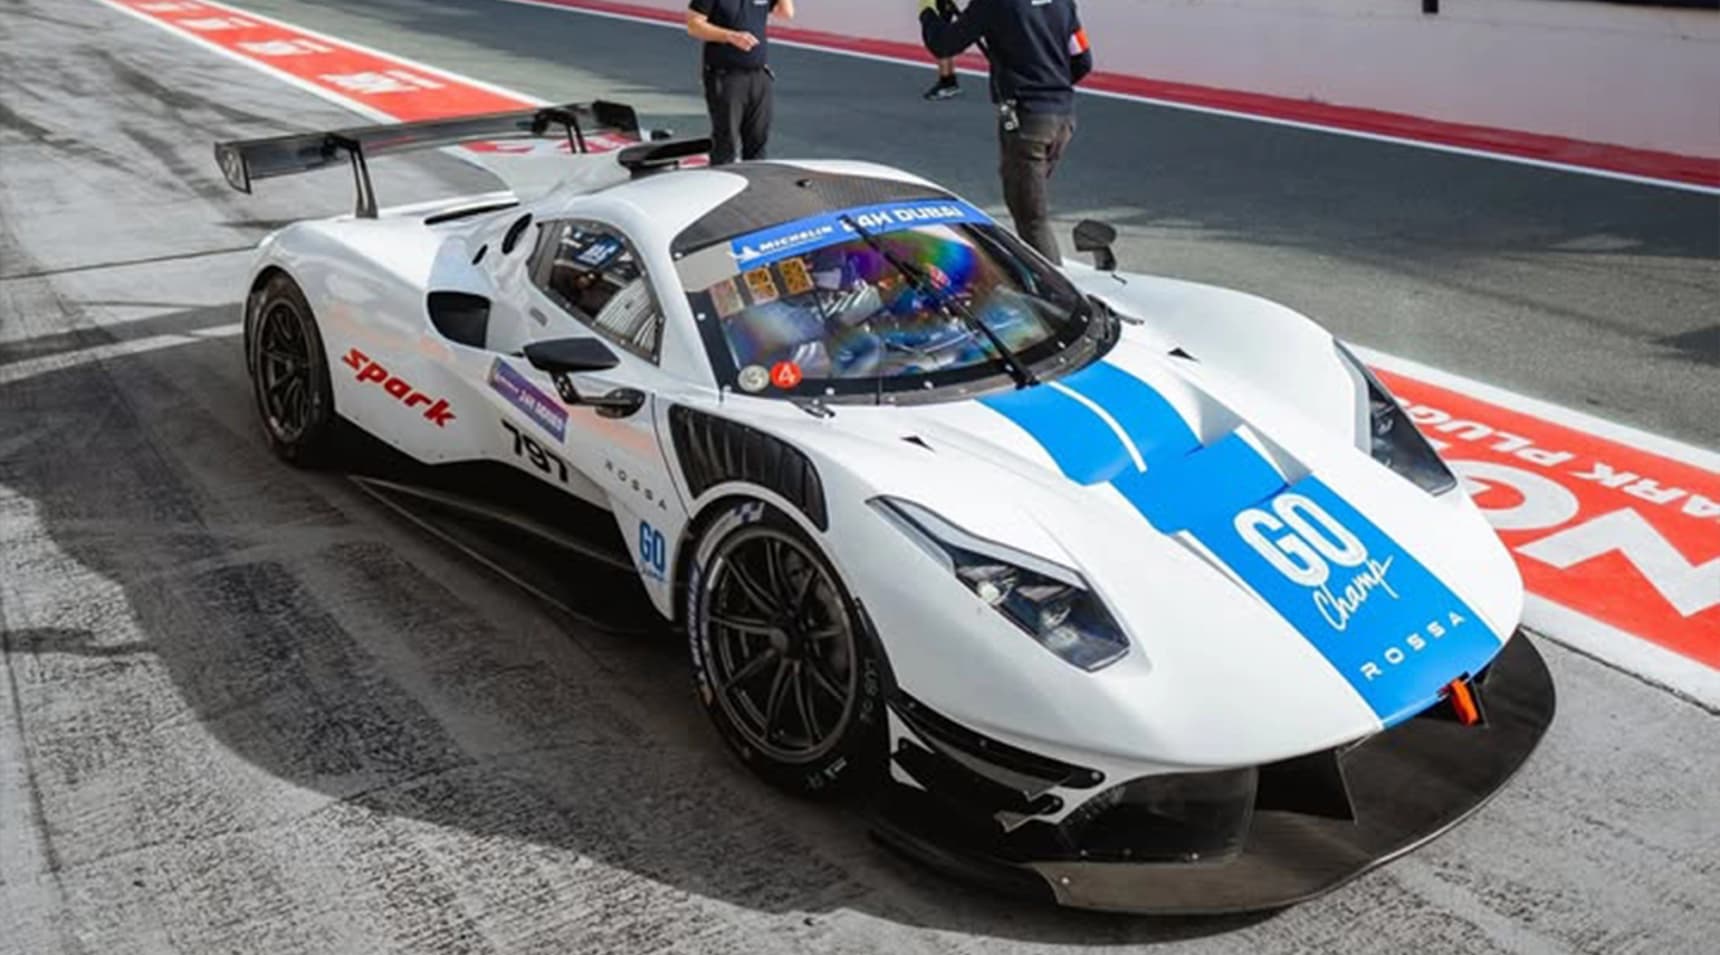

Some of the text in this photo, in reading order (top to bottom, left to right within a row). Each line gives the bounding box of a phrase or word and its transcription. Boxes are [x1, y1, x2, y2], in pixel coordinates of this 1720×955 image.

[759, 225, 833, 252] MICHELIN
[341, 347, 457, 428] spark
[778, 361, 796, 385] 4
[500, 418, 569, 483] 797
[605, 459, 667, 511] ROSSA
[1568, 462, 1720, 524] ARK
[639, 520, 666, 574] GO
[1233, 492, 1369, 587] GO
[1313, 555, 1399, 632] Champ
[1359, 610, 1467, 681] ROSSA
